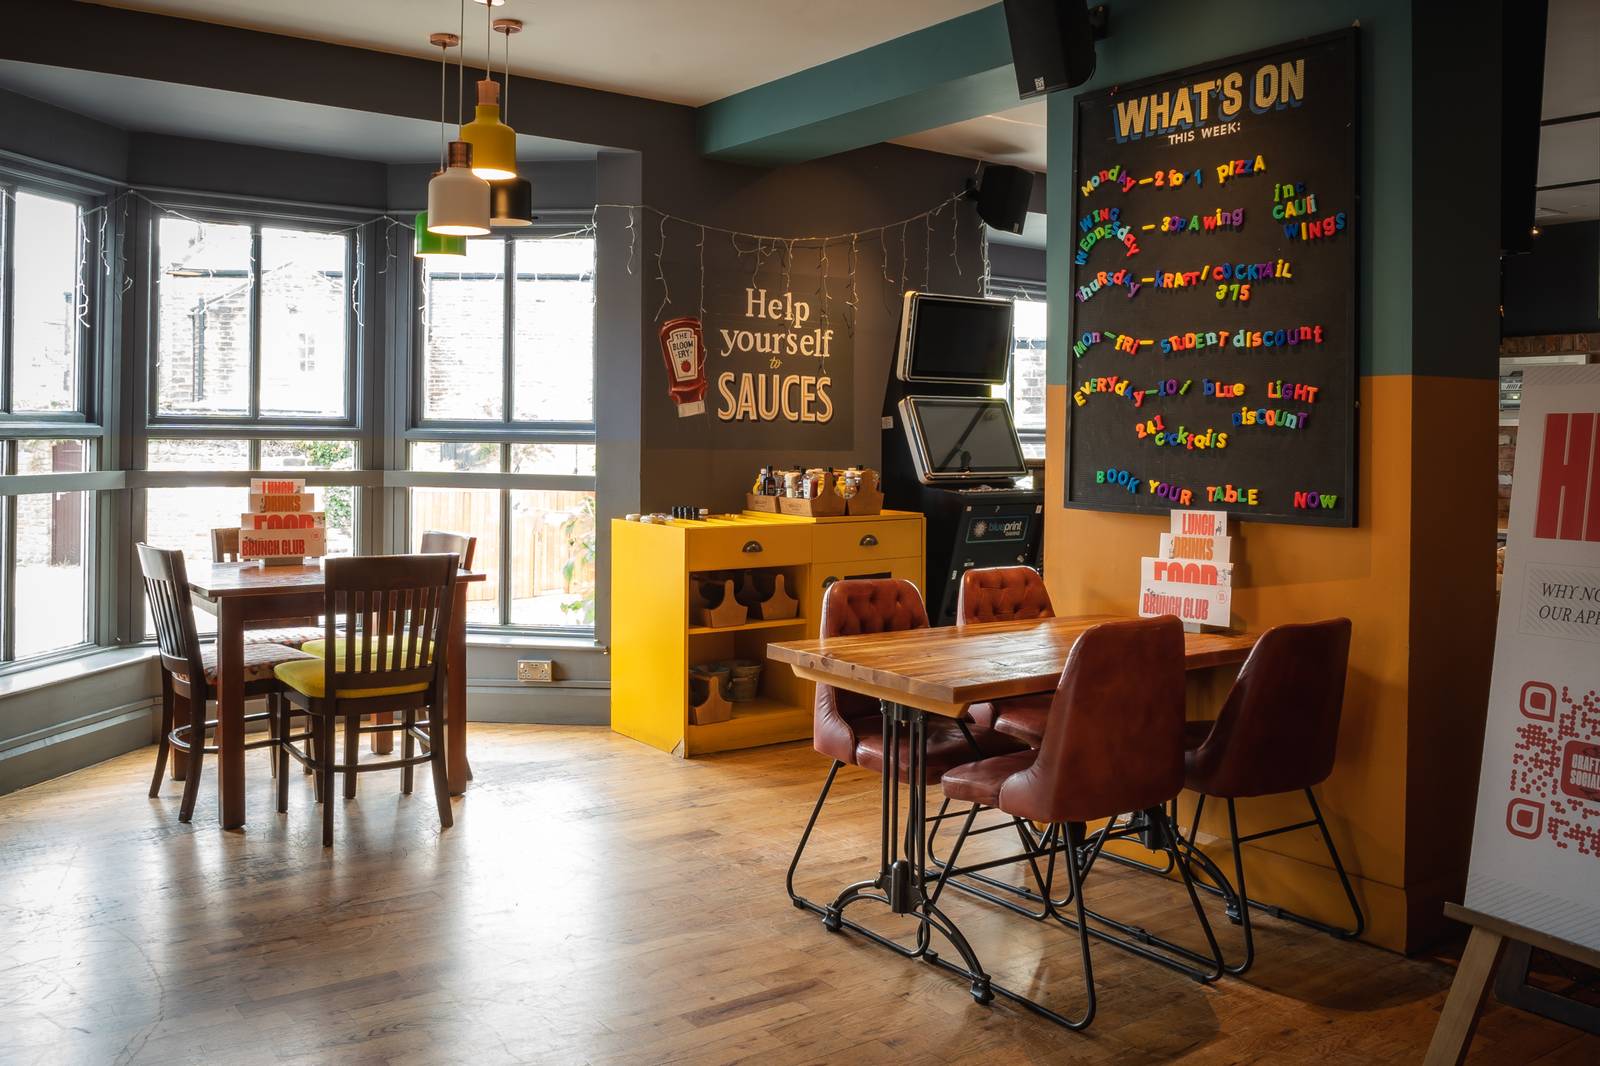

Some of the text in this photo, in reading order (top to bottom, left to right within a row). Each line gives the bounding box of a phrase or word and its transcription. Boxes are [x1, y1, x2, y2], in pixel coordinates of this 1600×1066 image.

[1116, 58, 1306, 138] WHAT'S ON
[1168, 121, 1241, 145] THIS WEEK:
[1215, 284, 1251, 301] 375
[745, 287, 811, 329] Help
[675, 332, 688, 340] THE
[720, 328, 834, 358] yourself
[717, 371, 834, 424] SAUCES
[1135, 414, 1166, 439] 241
[1096, 468, 1141, 494] BOOK
[1149, 479, 1193, 507] YOUR
[1293, 491, 1338, 510] NOW
[1182, 512, 1216, 536] LUNCH
[241, 538, 305, 557] BRUNCH CLUB
[1541, 582, 1580, 600] WHY
[1183, 596, 1209, 621] CLUB
[1538, 604, 1573, 622] OUR
